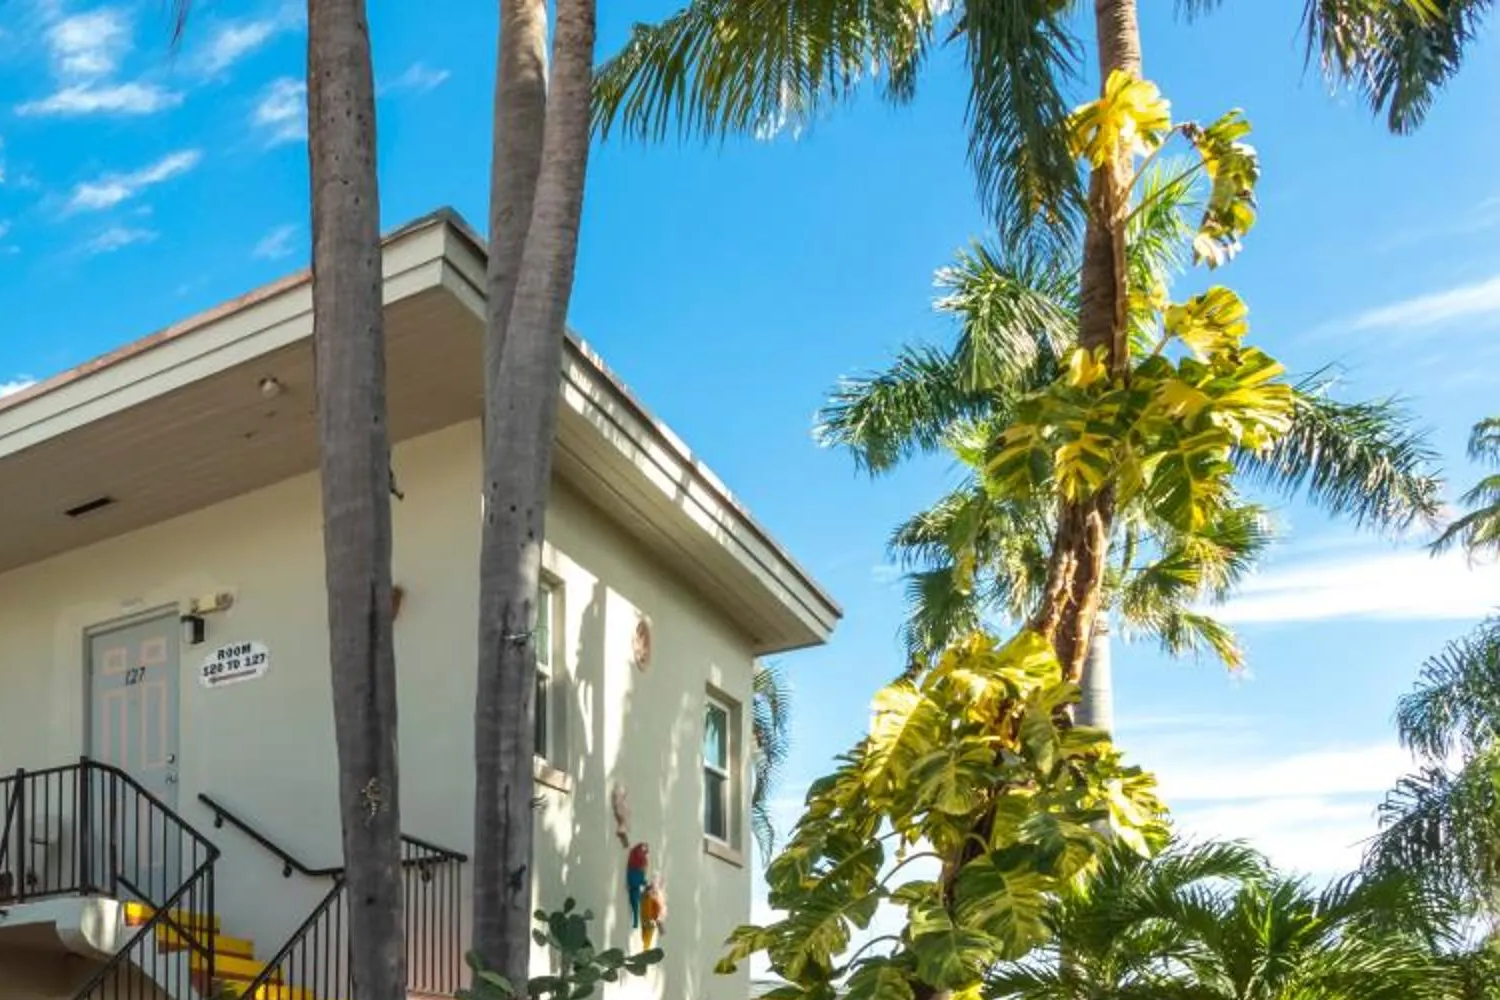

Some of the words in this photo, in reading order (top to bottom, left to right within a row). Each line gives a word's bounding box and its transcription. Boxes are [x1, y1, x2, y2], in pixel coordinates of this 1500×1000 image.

[218, 643, 251, 660] ROOM
[226, 659, 241, 671] TO
[125, 666, 146, 686] 127
